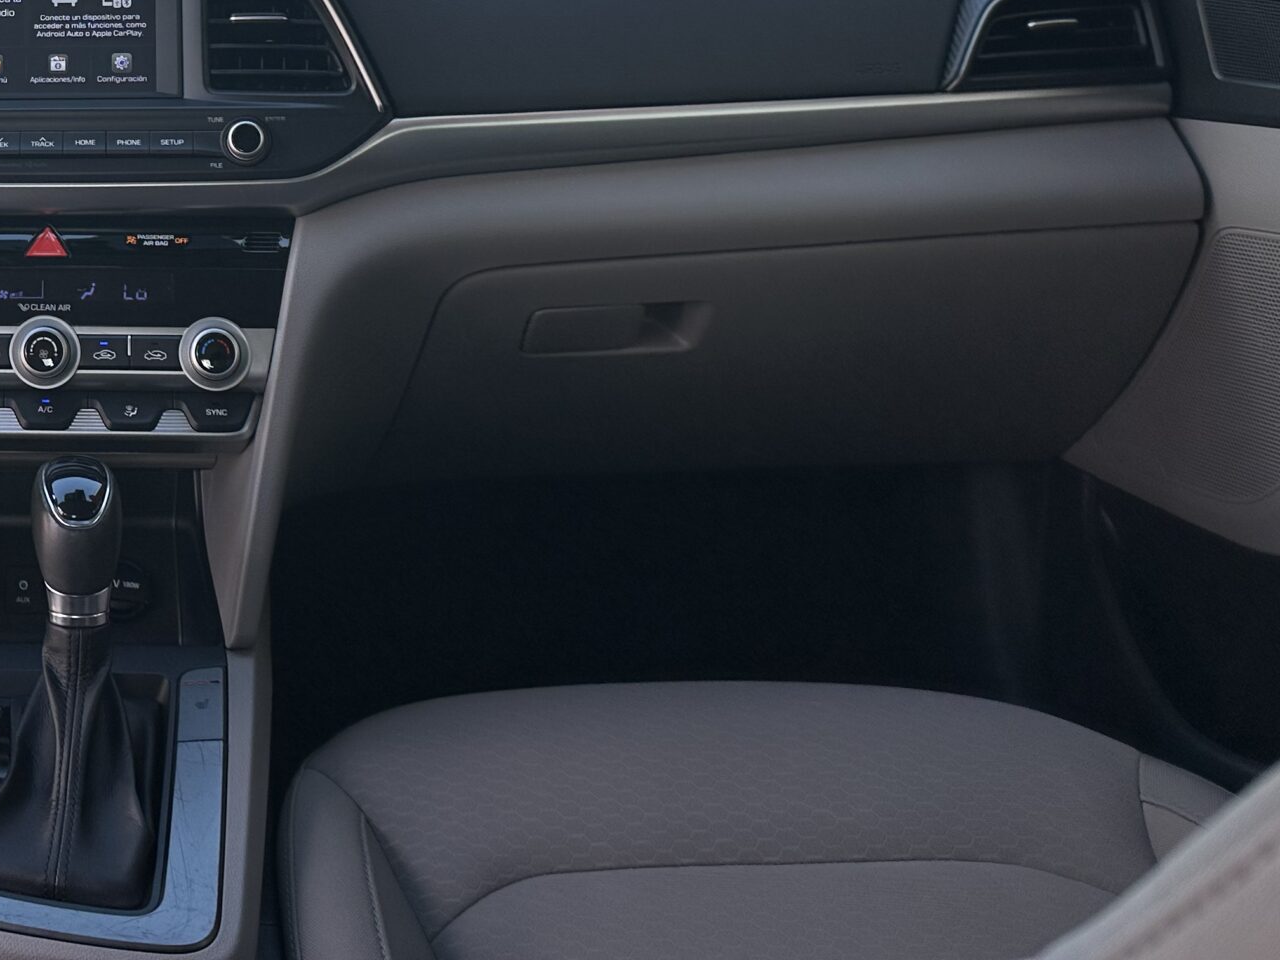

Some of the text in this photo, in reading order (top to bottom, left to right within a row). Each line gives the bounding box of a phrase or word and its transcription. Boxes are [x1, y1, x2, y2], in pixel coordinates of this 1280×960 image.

[82, 14, 121, 22] dispositivo
[36, 30, 65, 38] Android
[92, 30, 113, 38] Apple
[160, 138, 184, 146] SETUP
[30, 303, 71, 311] CLEAN AIR
[37, 404, 54, 414] A/C
[205, 407, 228, 417] SYNC
